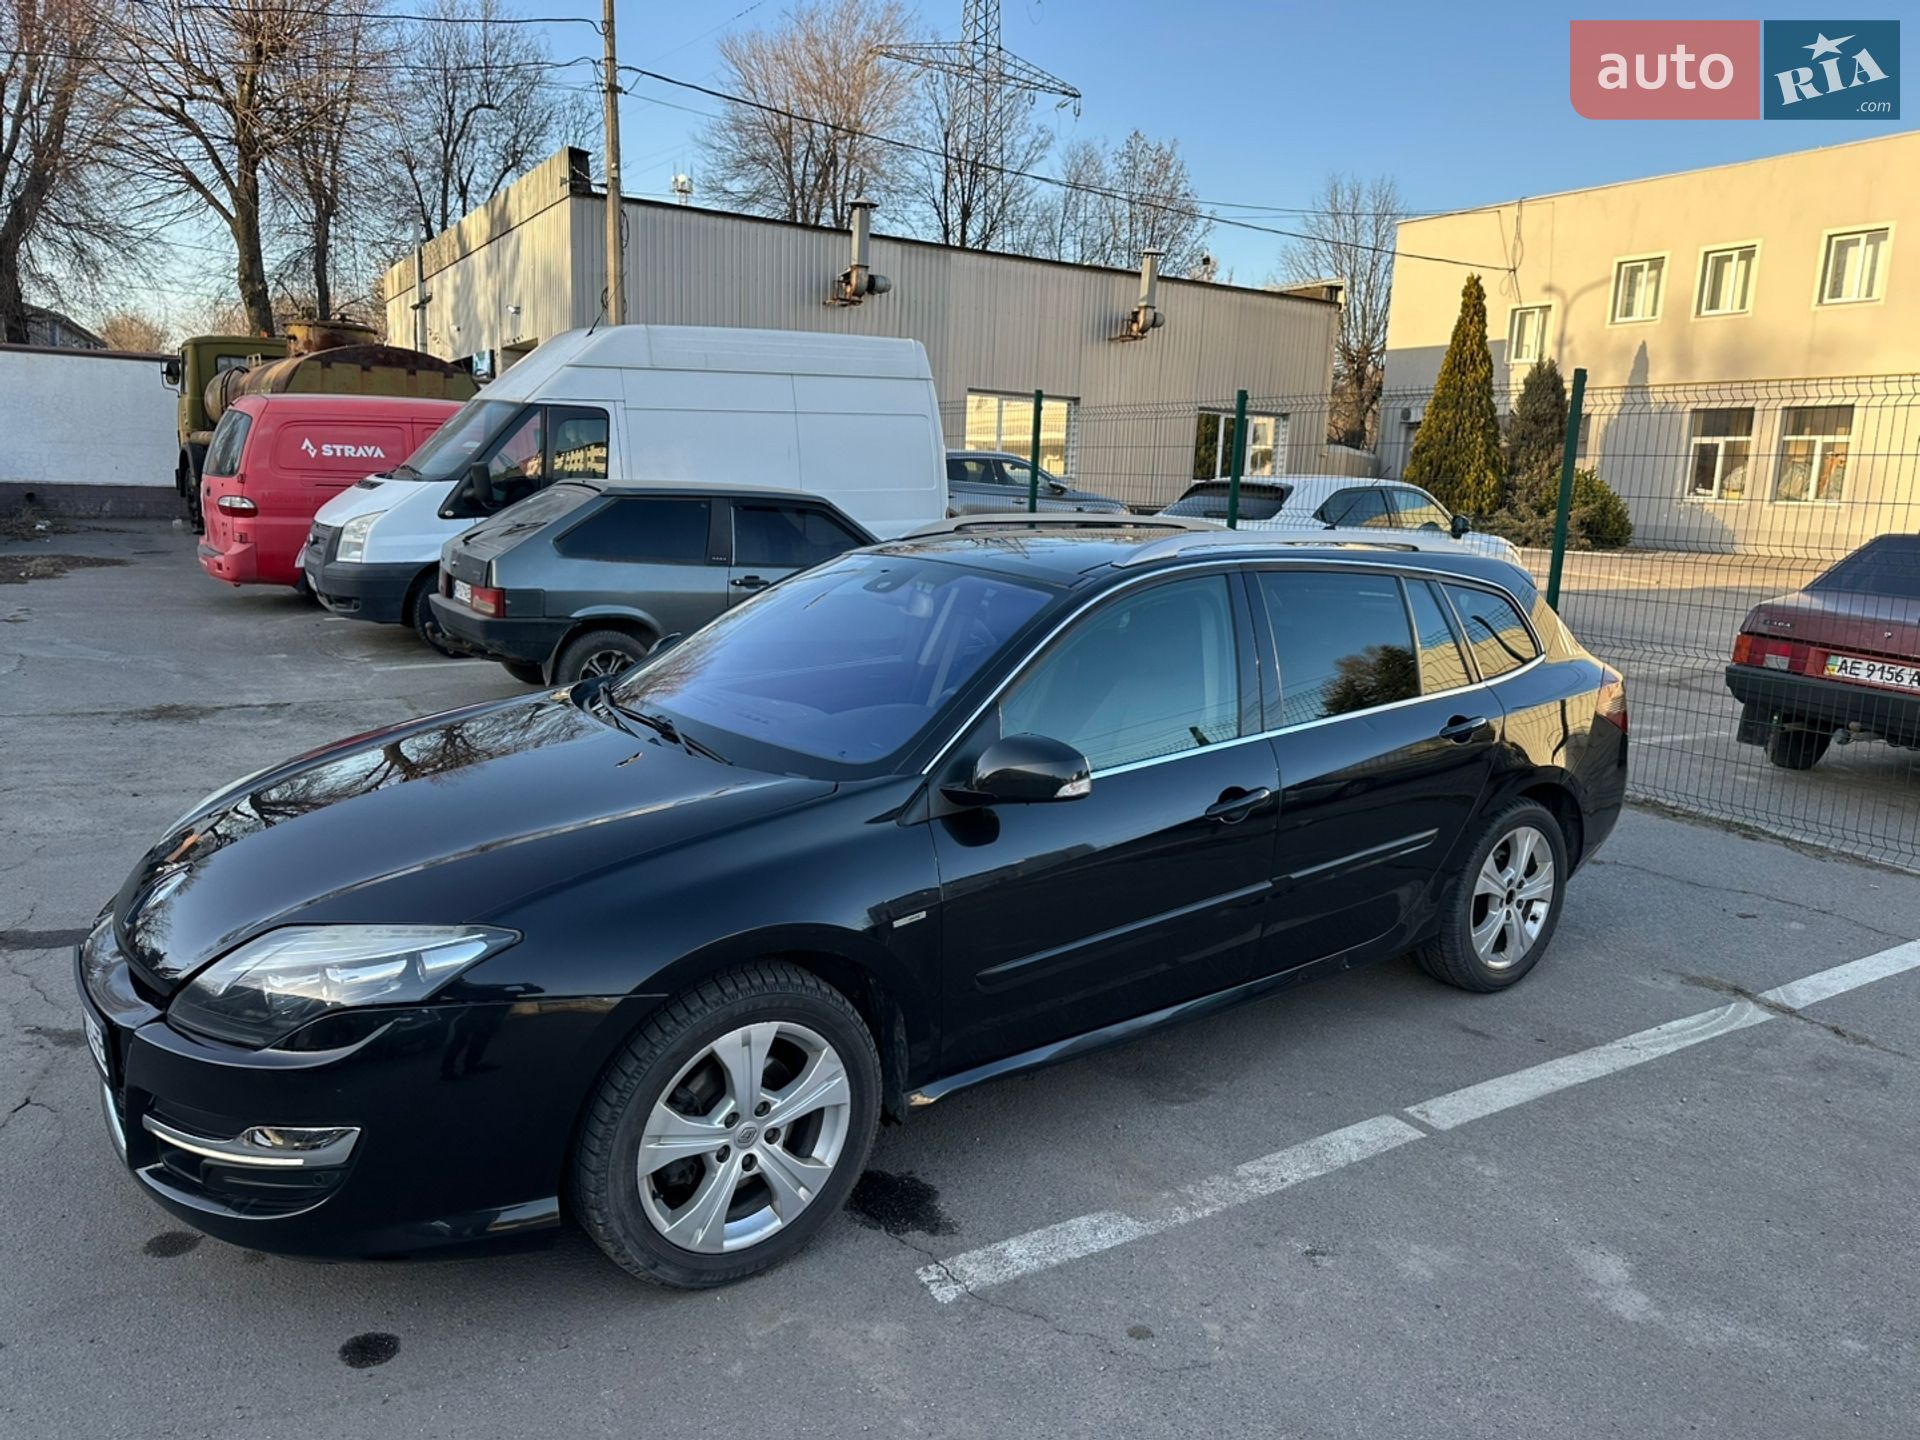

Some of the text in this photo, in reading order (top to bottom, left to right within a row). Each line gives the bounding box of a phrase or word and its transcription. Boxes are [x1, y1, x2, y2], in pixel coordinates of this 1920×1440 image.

[321, 444, 385, 458] STRAVA
[1837, 659, 1862, 677] AE
[1866, 663, 1905, 683] 9156
